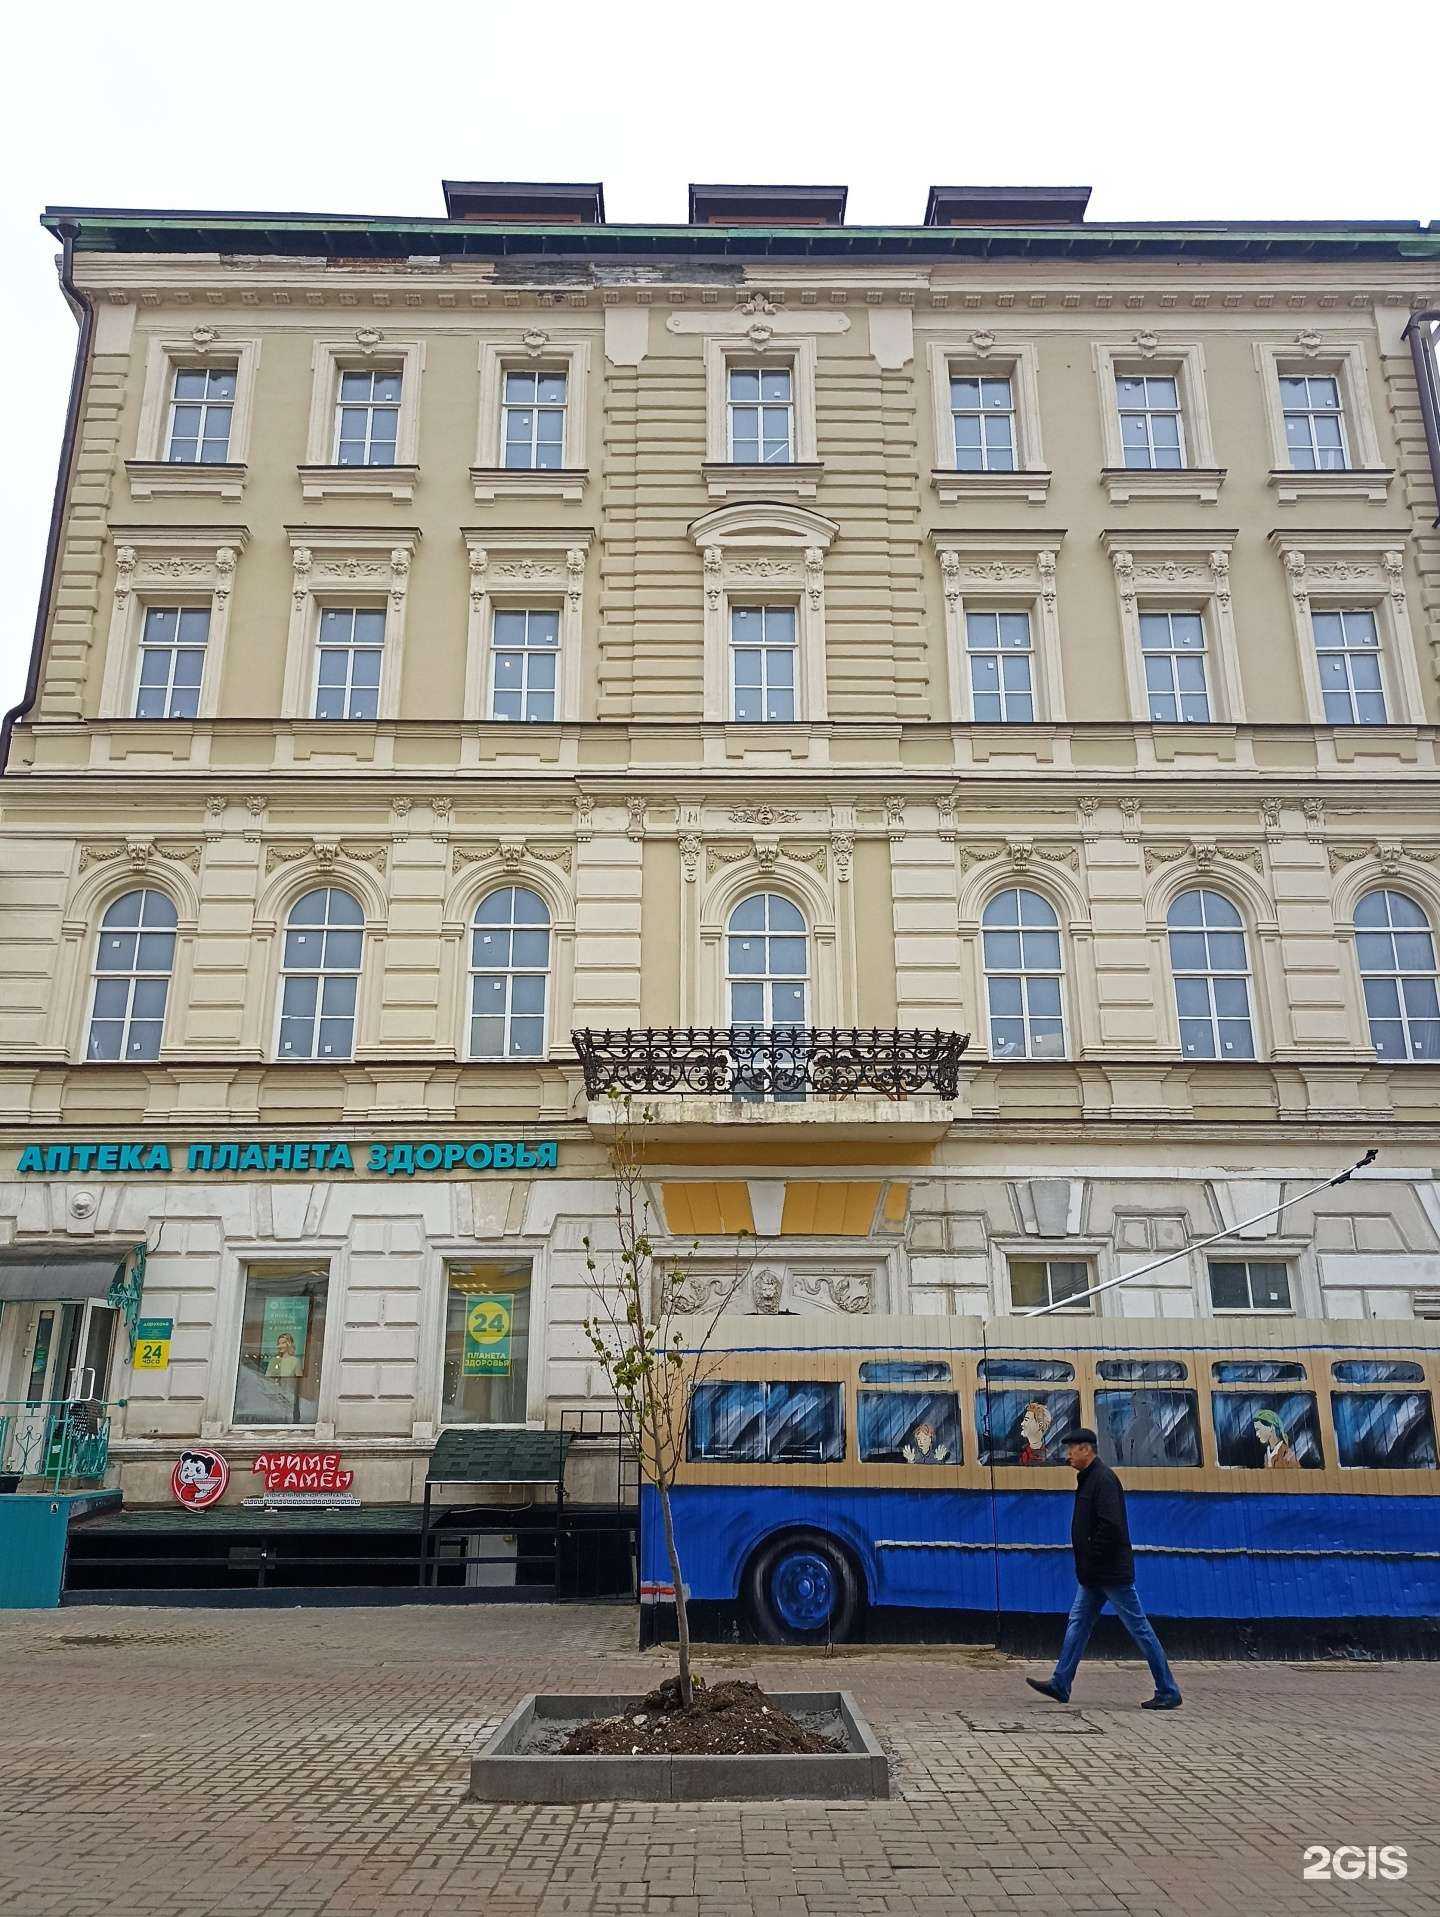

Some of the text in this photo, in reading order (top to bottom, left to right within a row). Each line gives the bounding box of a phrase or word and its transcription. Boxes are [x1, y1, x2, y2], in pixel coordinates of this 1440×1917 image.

[16, 1142, 559, 1177] АПТЕКА ПЛАНЕТА ЗДОРОВЬЯ
[471, 1312, 505, 1333] 24
[142, 1344, 162, 1359] 24
[467, 1352, 506, 1360] ПЛАНЕТА
[464, 1359, 511, 1368] ЗДОРОВЬЯ
[254, 1455, 337, 1471] АНИМЕ
[268, 1472, 351, 1488] РАМЕН
